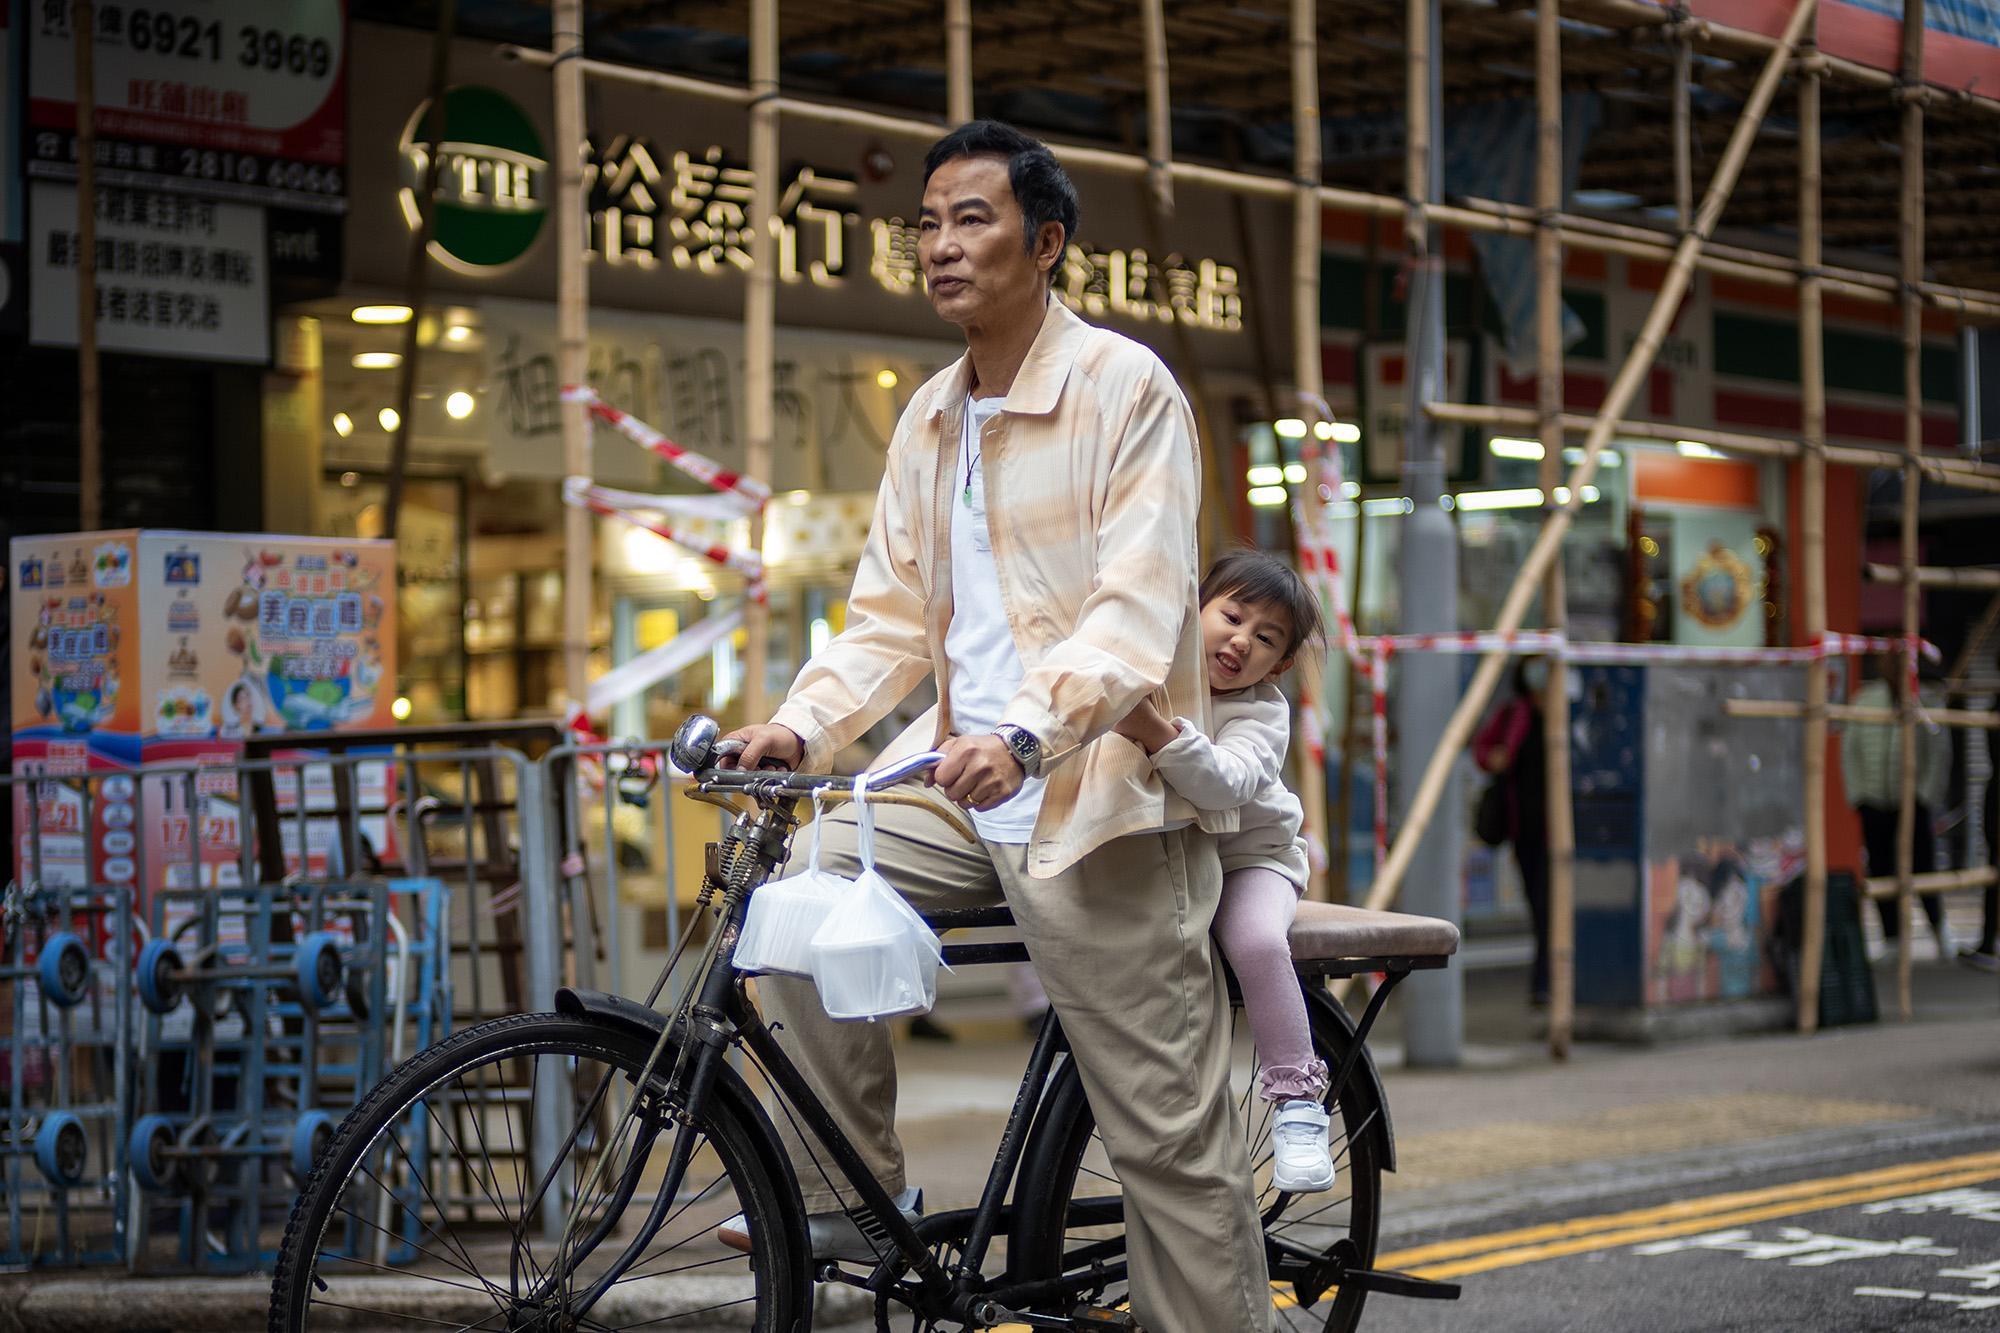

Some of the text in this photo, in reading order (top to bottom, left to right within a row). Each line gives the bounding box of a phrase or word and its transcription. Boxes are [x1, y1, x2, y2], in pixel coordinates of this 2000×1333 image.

[129, 9, 221, 62] 6921
[239, 25, 330, 78] 3969
[179, 148, 258, 183] 2810
[208, 817, 237, 846] 21
